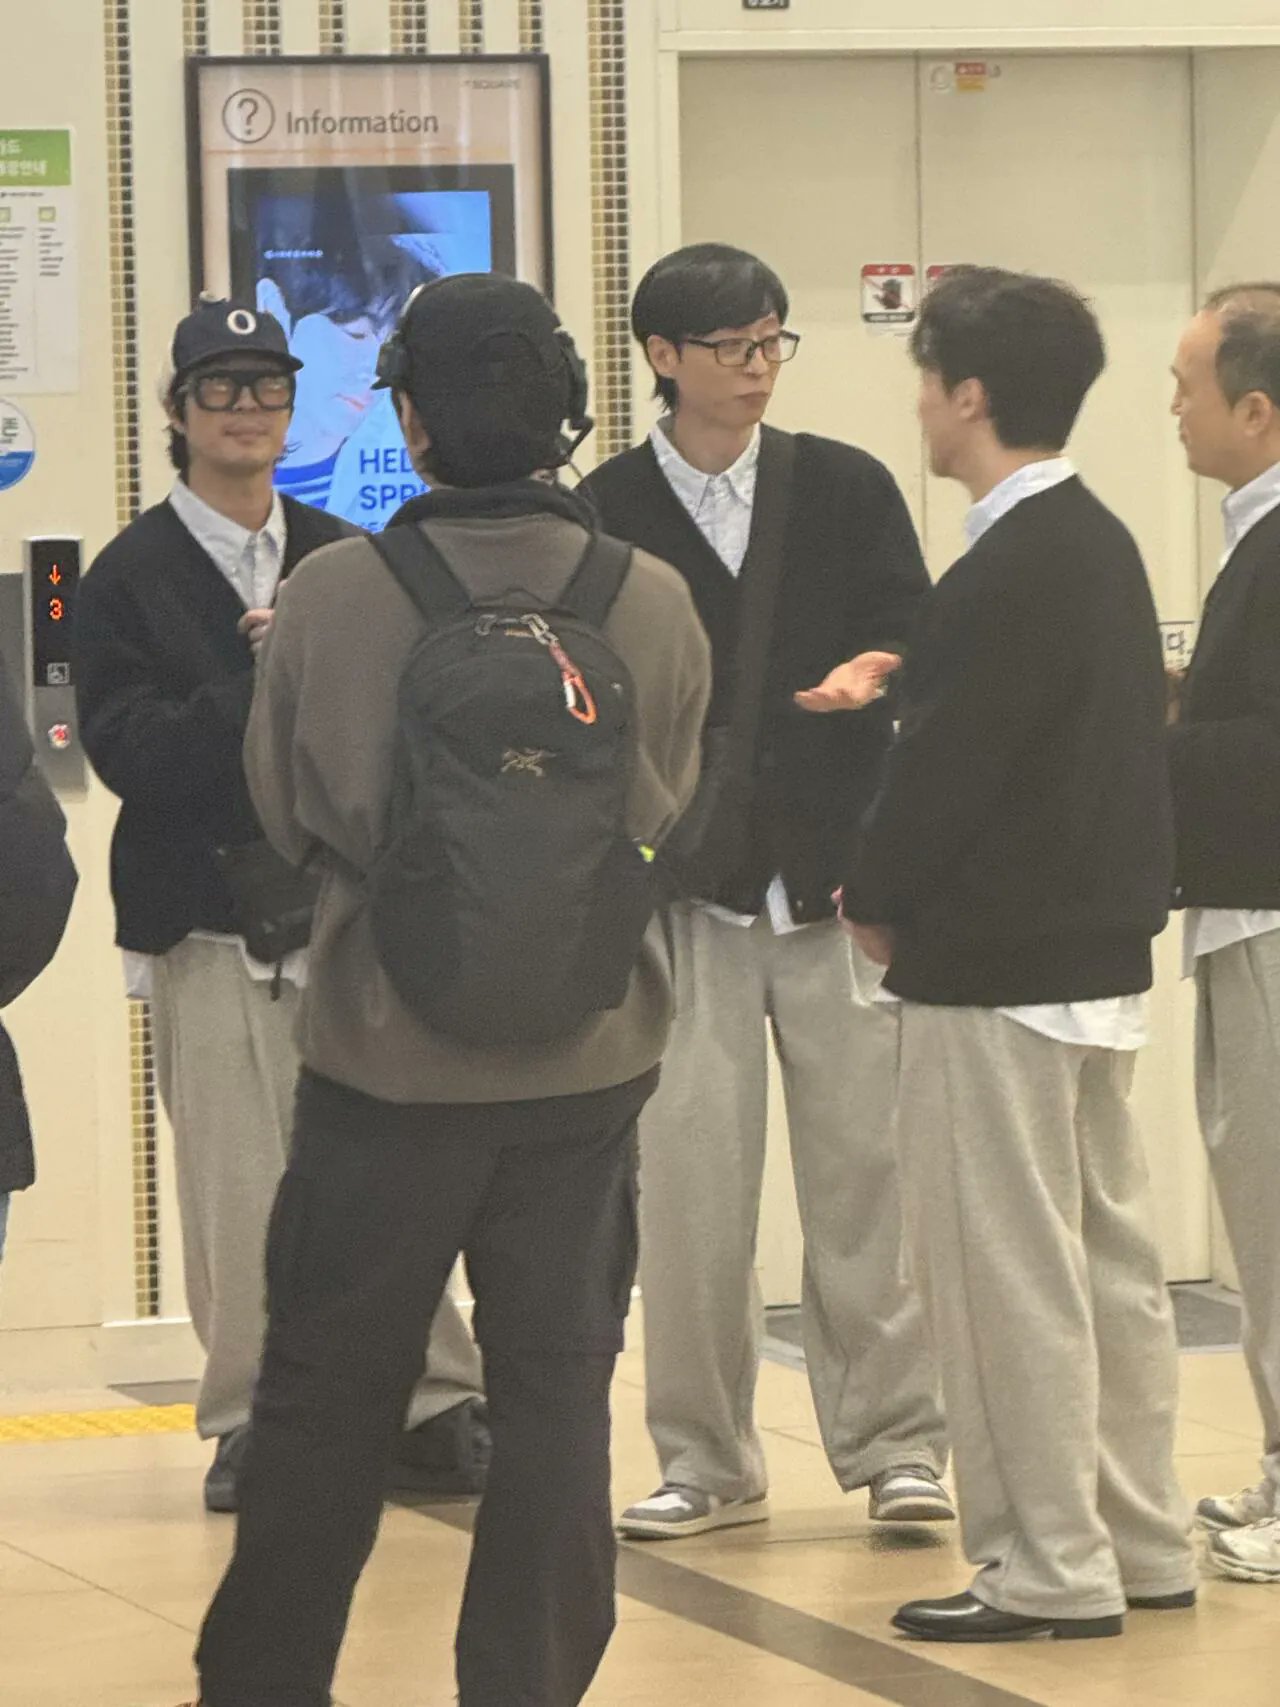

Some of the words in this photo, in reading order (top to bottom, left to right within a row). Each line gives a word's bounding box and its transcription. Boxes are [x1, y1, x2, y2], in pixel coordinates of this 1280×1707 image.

[286, 109, 439, 135] Information
[227, 309, 257, 335] O
[50, 598, 65, 621] 3
